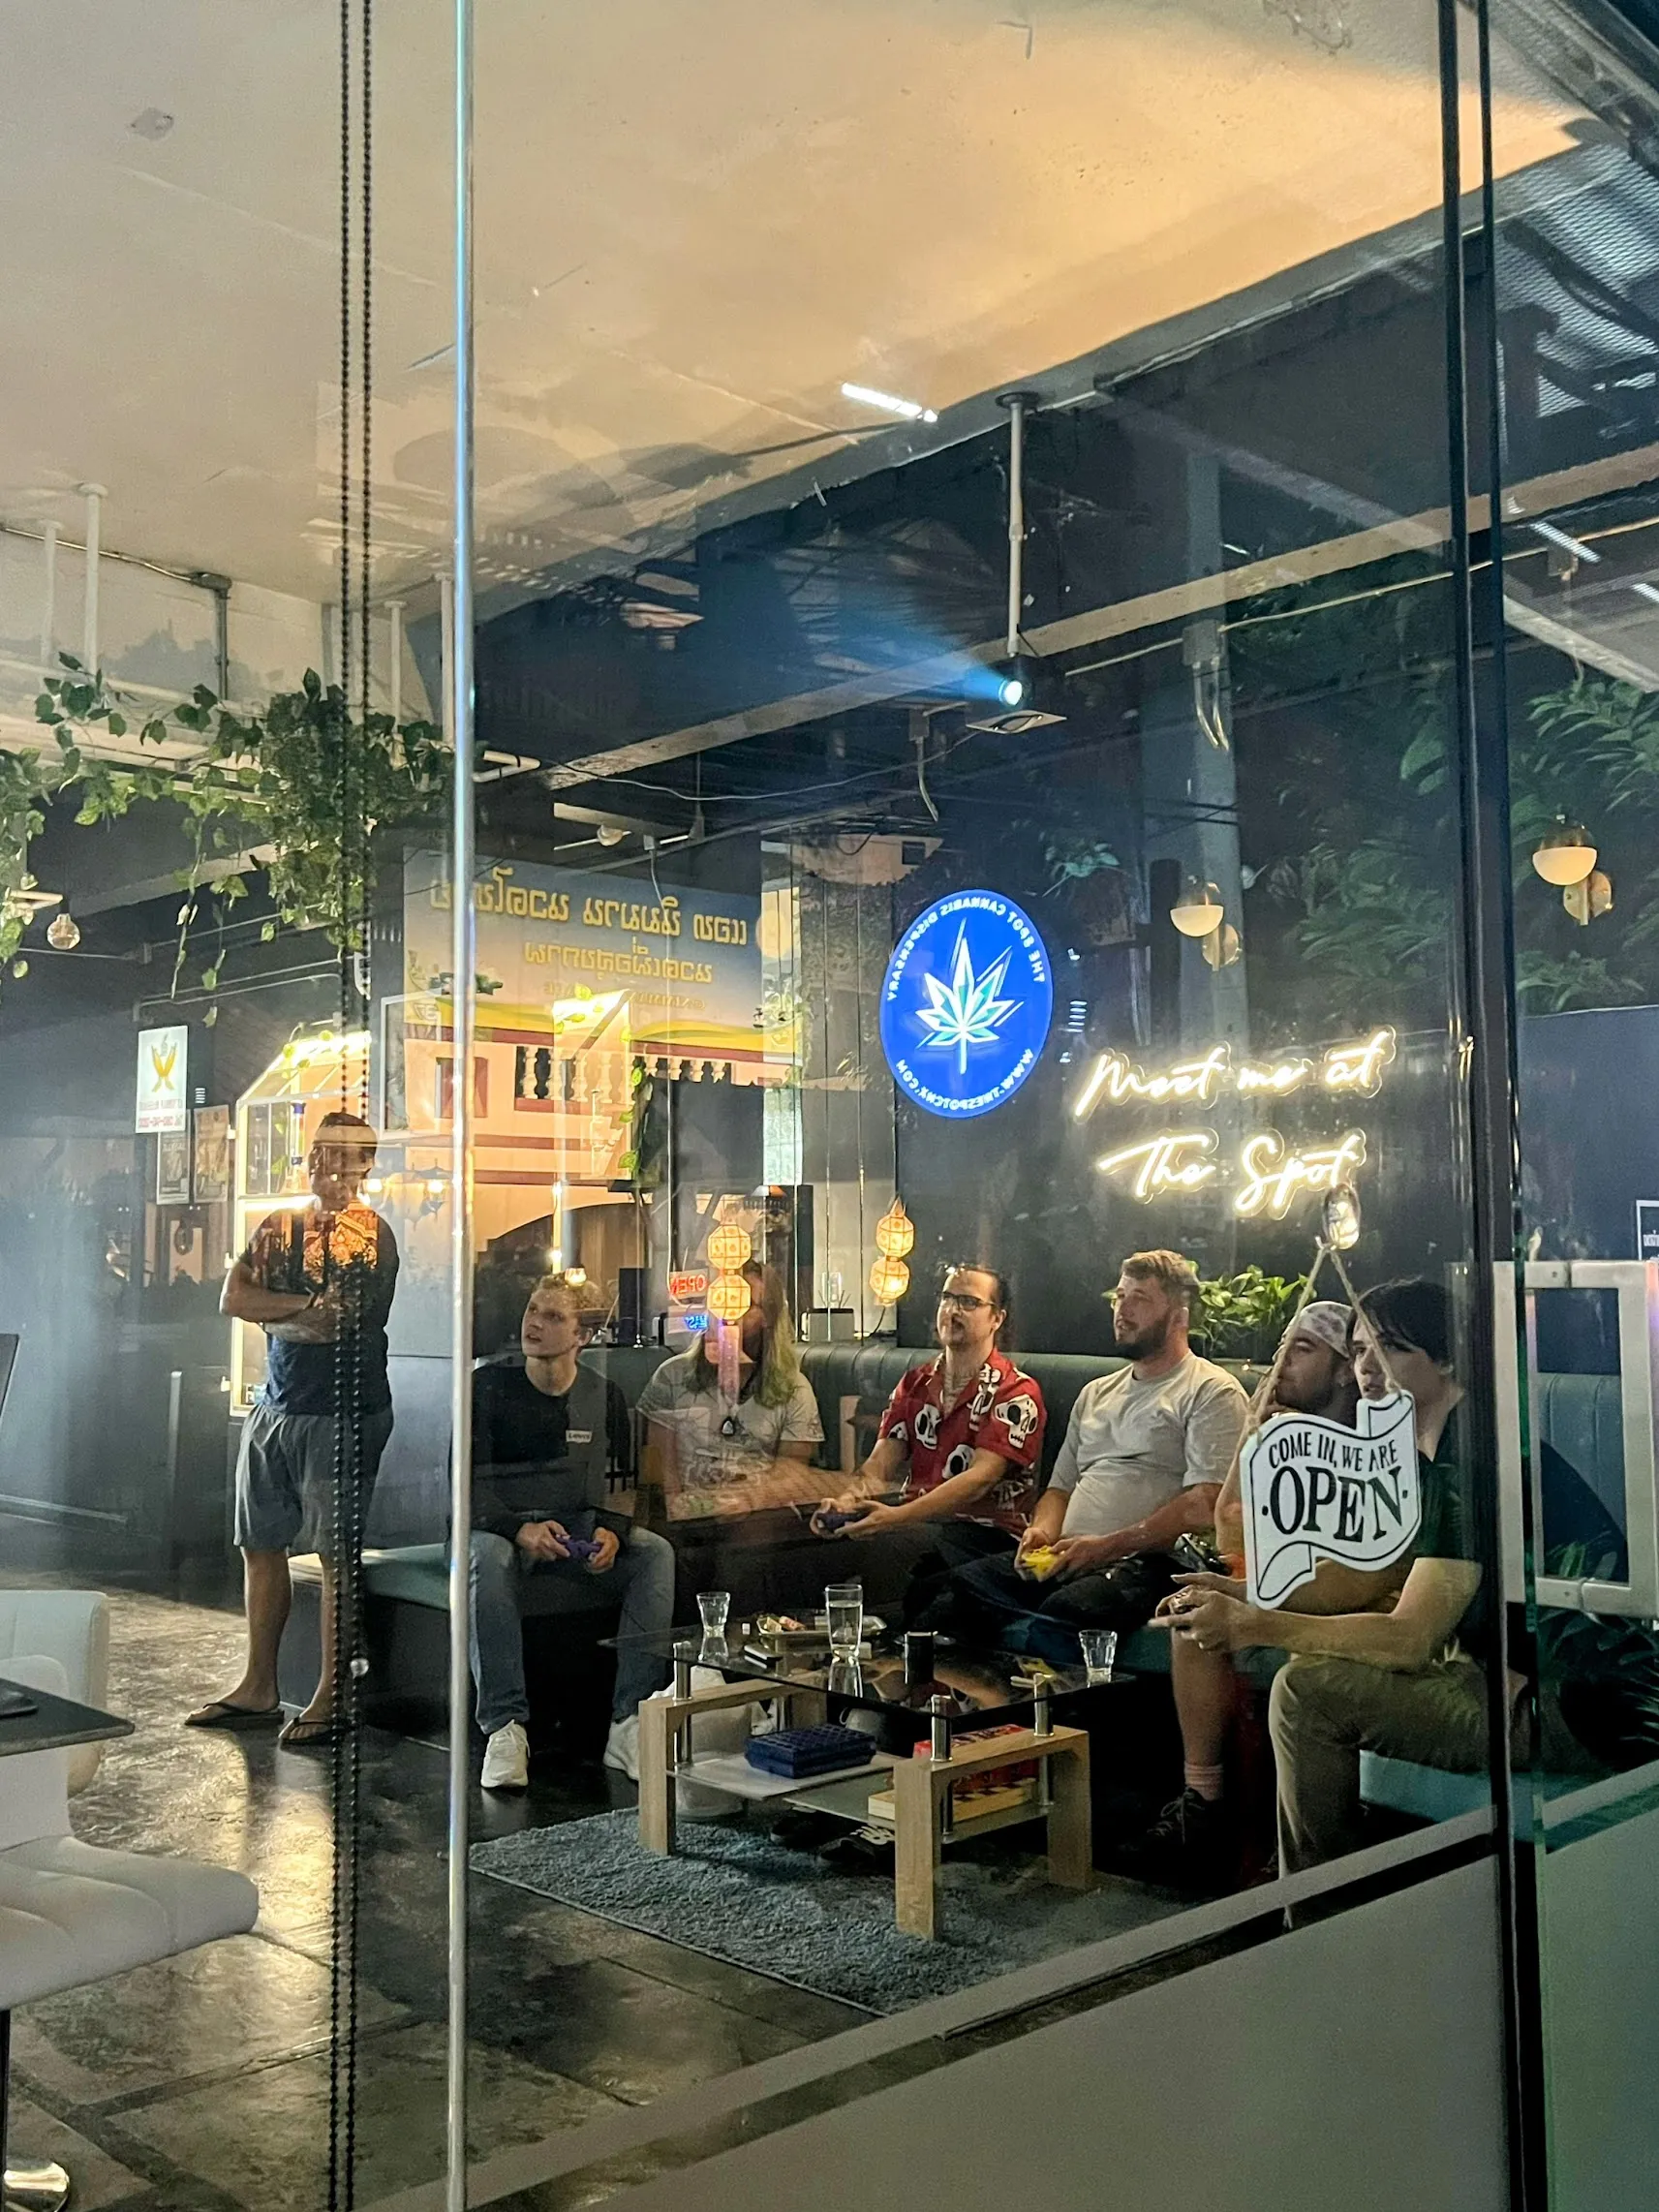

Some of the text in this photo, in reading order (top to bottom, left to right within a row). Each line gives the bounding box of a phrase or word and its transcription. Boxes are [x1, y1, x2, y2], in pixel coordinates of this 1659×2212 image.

[1074, 1030, 1392, 1116] Meet me at
[1096, 1134, 1361, 1211] The Spot
[1268, 1431, 1398, 1472] COME IN, WE ARE
[1270, 1464, 1402, 1543] OPEN
